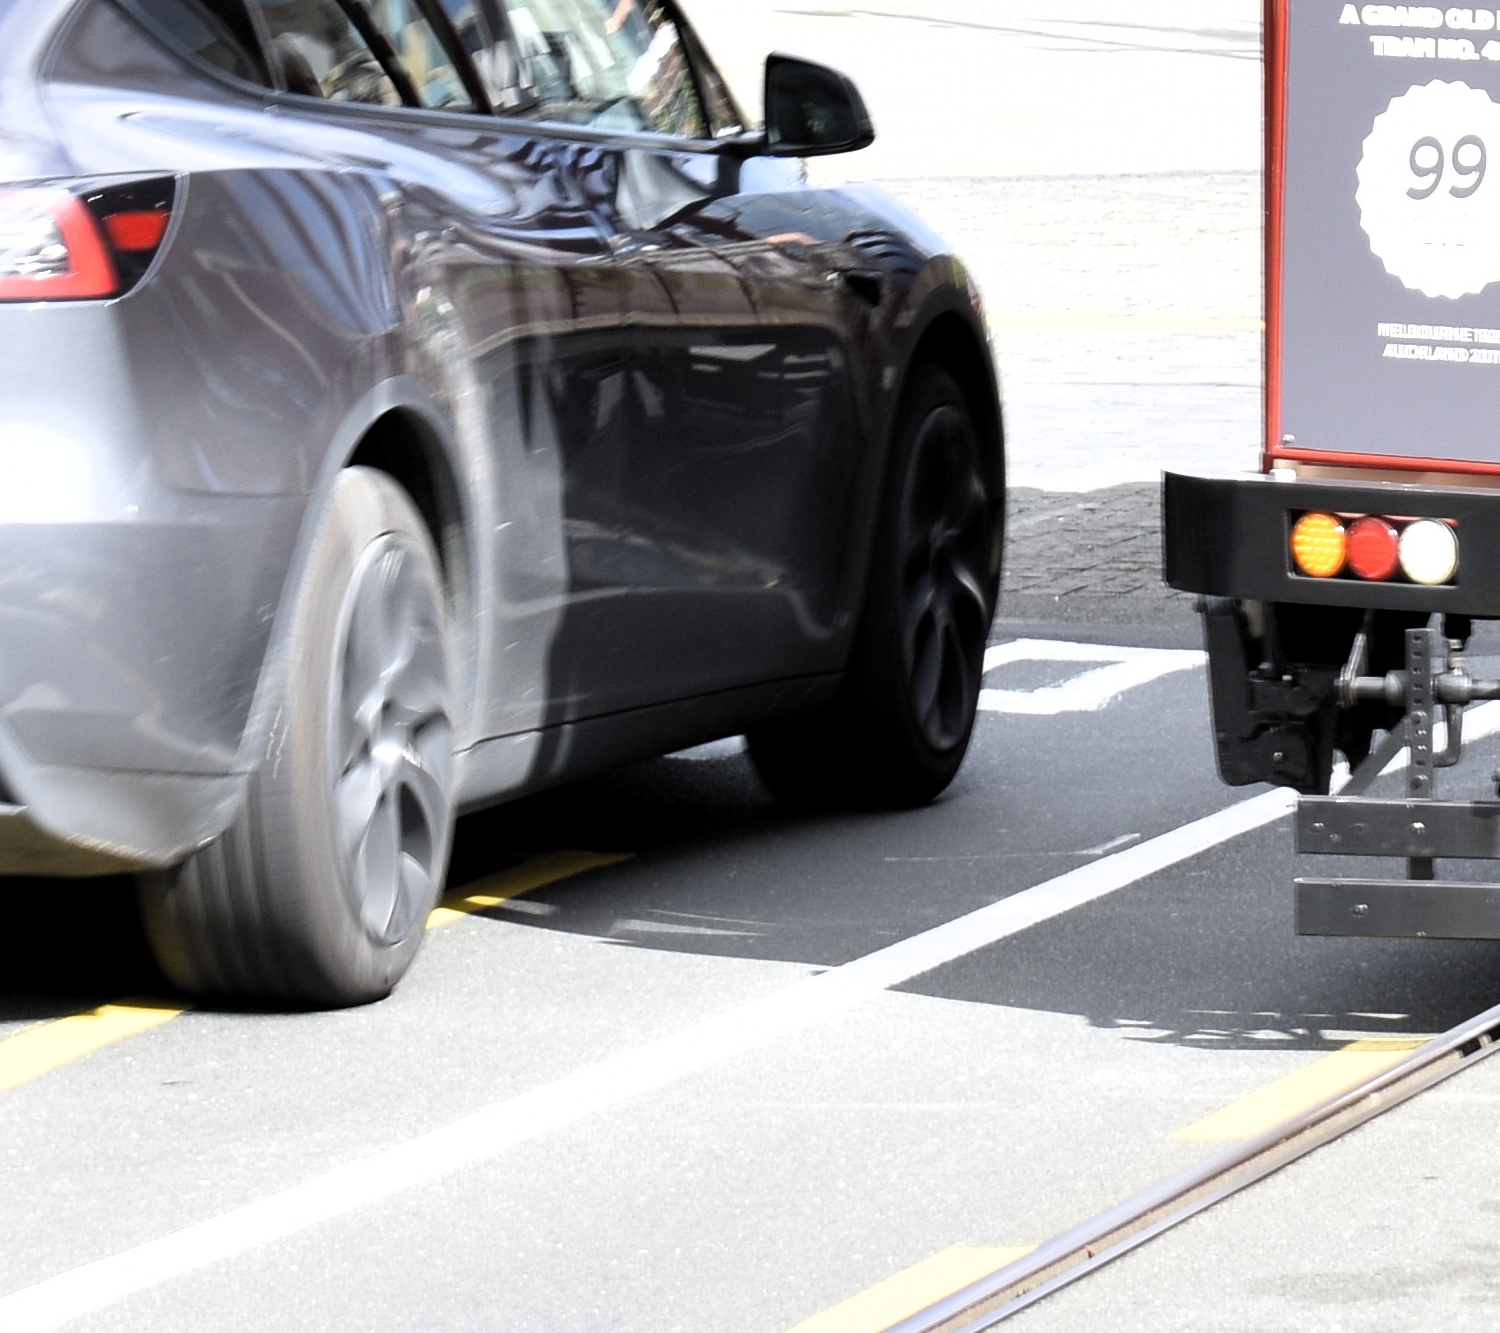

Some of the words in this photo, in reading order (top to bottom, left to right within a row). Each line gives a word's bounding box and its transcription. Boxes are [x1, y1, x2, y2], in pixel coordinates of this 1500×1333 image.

[1339, 4, 1360, 25] A
[1362, 5, 1443, 27] GRAND
[1445, 8, 1495, 30] OLD
[1370, 36, 1436, 58] TRAM
[1406, 133, 1488, 201] 99
